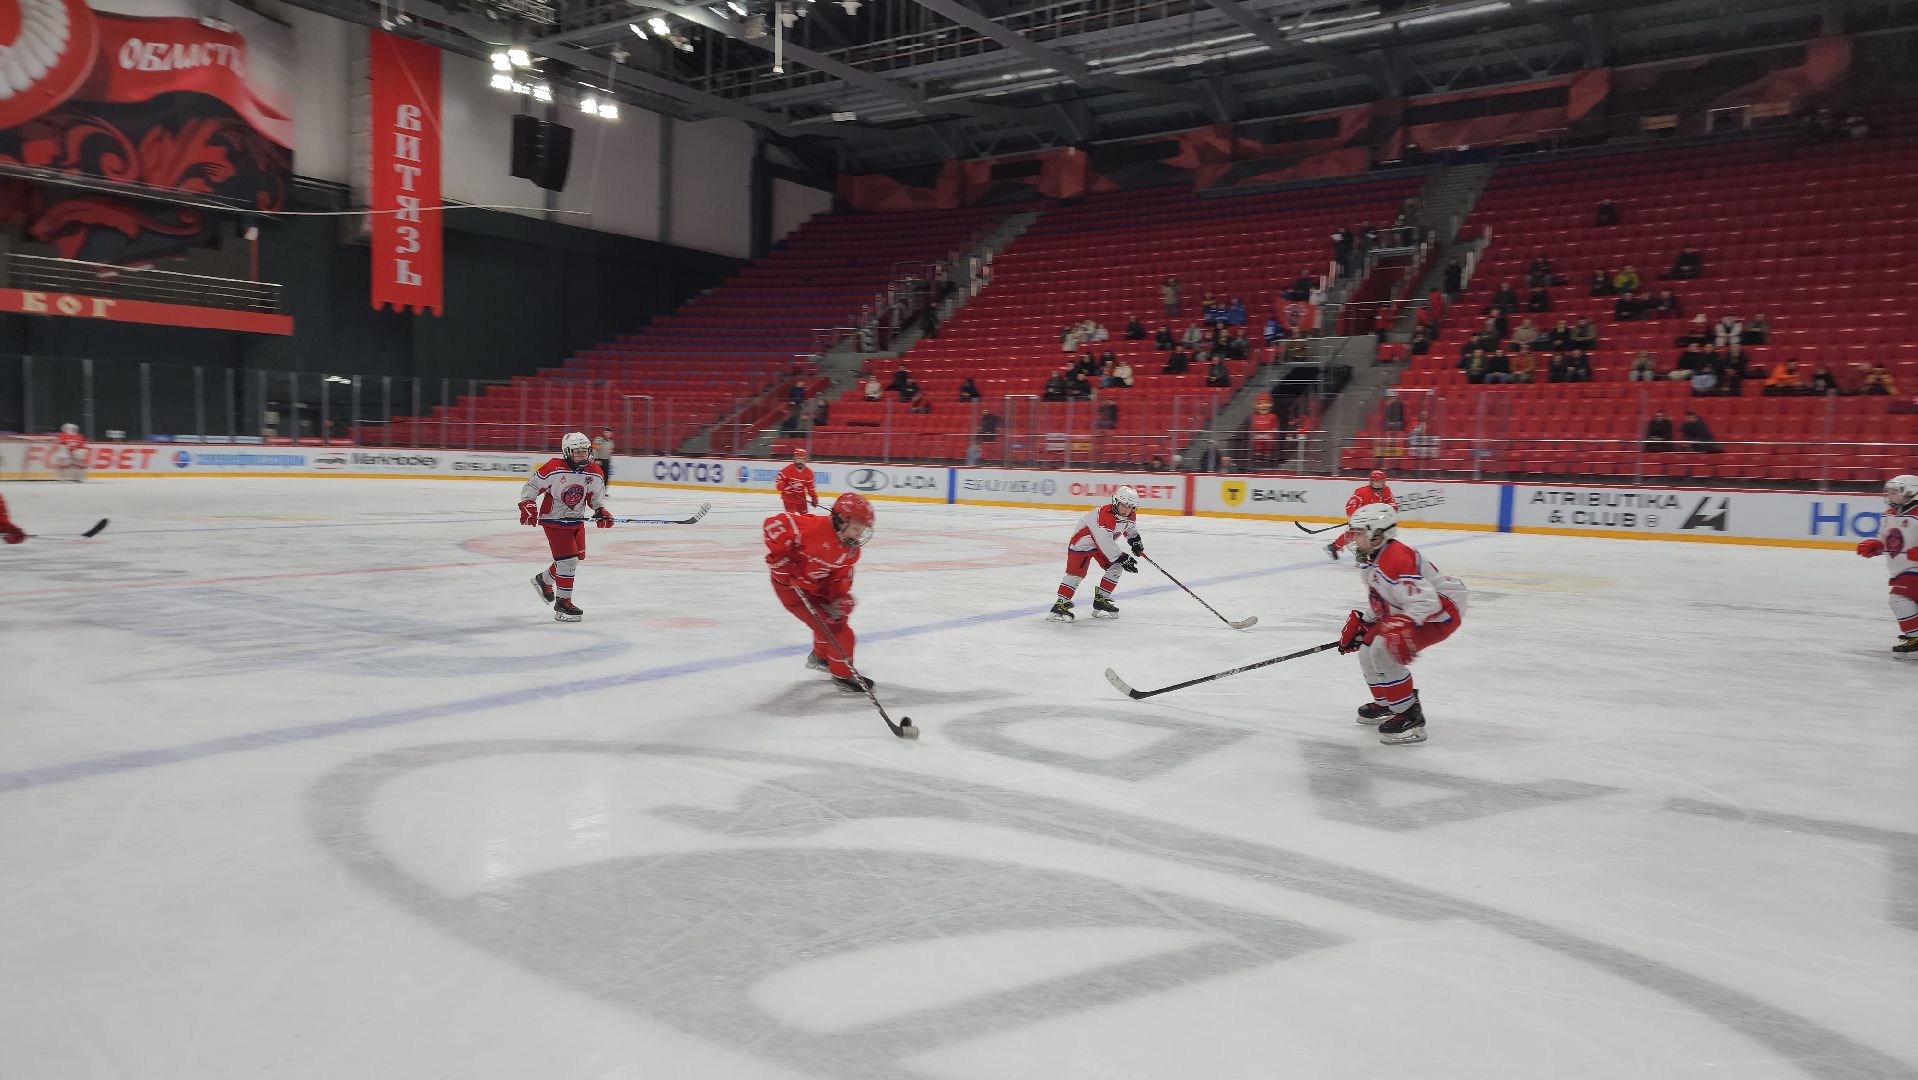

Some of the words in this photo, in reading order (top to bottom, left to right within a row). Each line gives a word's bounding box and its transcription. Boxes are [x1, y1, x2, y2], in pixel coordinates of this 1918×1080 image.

[393, 104, 422, 287] ВИТЯЗЬ
[22, 446, 158, 470] FOBET
[892, 475, 938, 490] LADA
[1069, 482, 1176, 500] OLIMBET
[1251, 488, 1308, 503] БАНК
[1529, 490, 1681, 510] ATRIBUTIKA
[1547, 509, 1566, 525] &
[1571, 510, 1638, 528] CLUB
